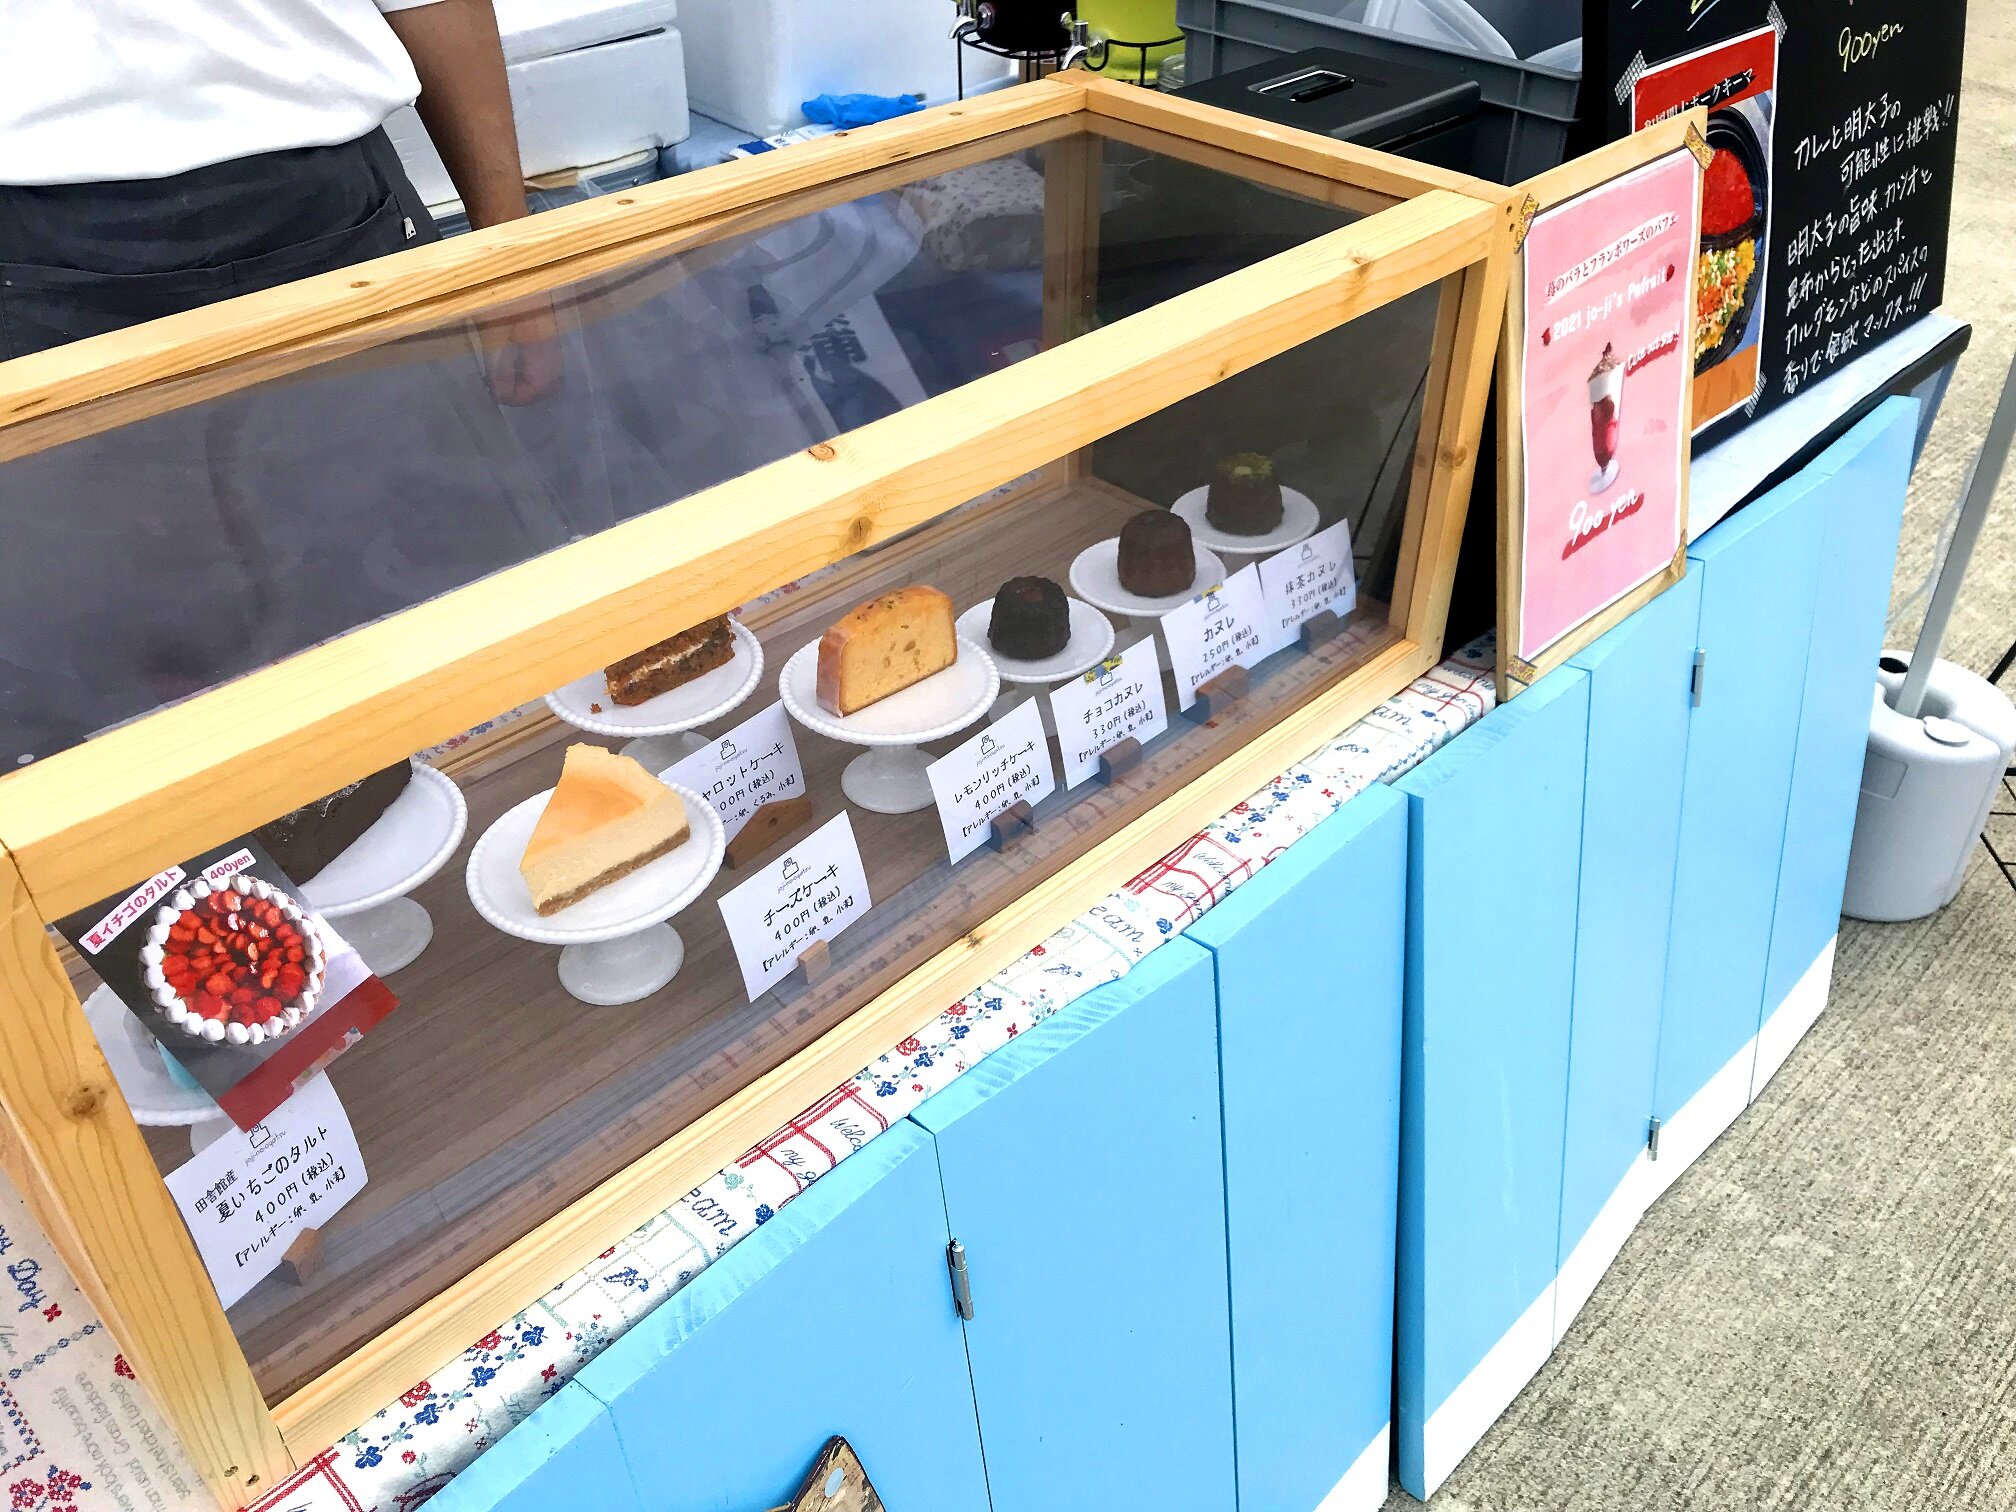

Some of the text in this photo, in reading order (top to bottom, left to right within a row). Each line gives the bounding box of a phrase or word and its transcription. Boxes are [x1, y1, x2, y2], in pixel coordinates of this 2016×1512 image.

[1838, 22, 1904, 72] 900yen
[1793, 92, 1901, 170] カレーと明太子の
[1553, 310, 1582, 342] 2021
[1569, 488, 1638, 546] 900 yen
[1204, 615, 1236, 643] カヌレ
[1082, 682, 1144, 724] チョコカヌレ
[702, 741, 785, 801] ャロットケーキ
[954, 740, 1036, 804] レモンリッチケーキ
[209, 852, 252, 881] 400yen
[85, 867, 178, 949] 夏イチゴのタルト
[763, 863, 840, 927] チーズケーキ
[194, 1169, 239, 1214] 田舎館産
[216, 1125, 328, 1223] 夏いちごのタルト
[7, 1258, 47, 1313] Day
